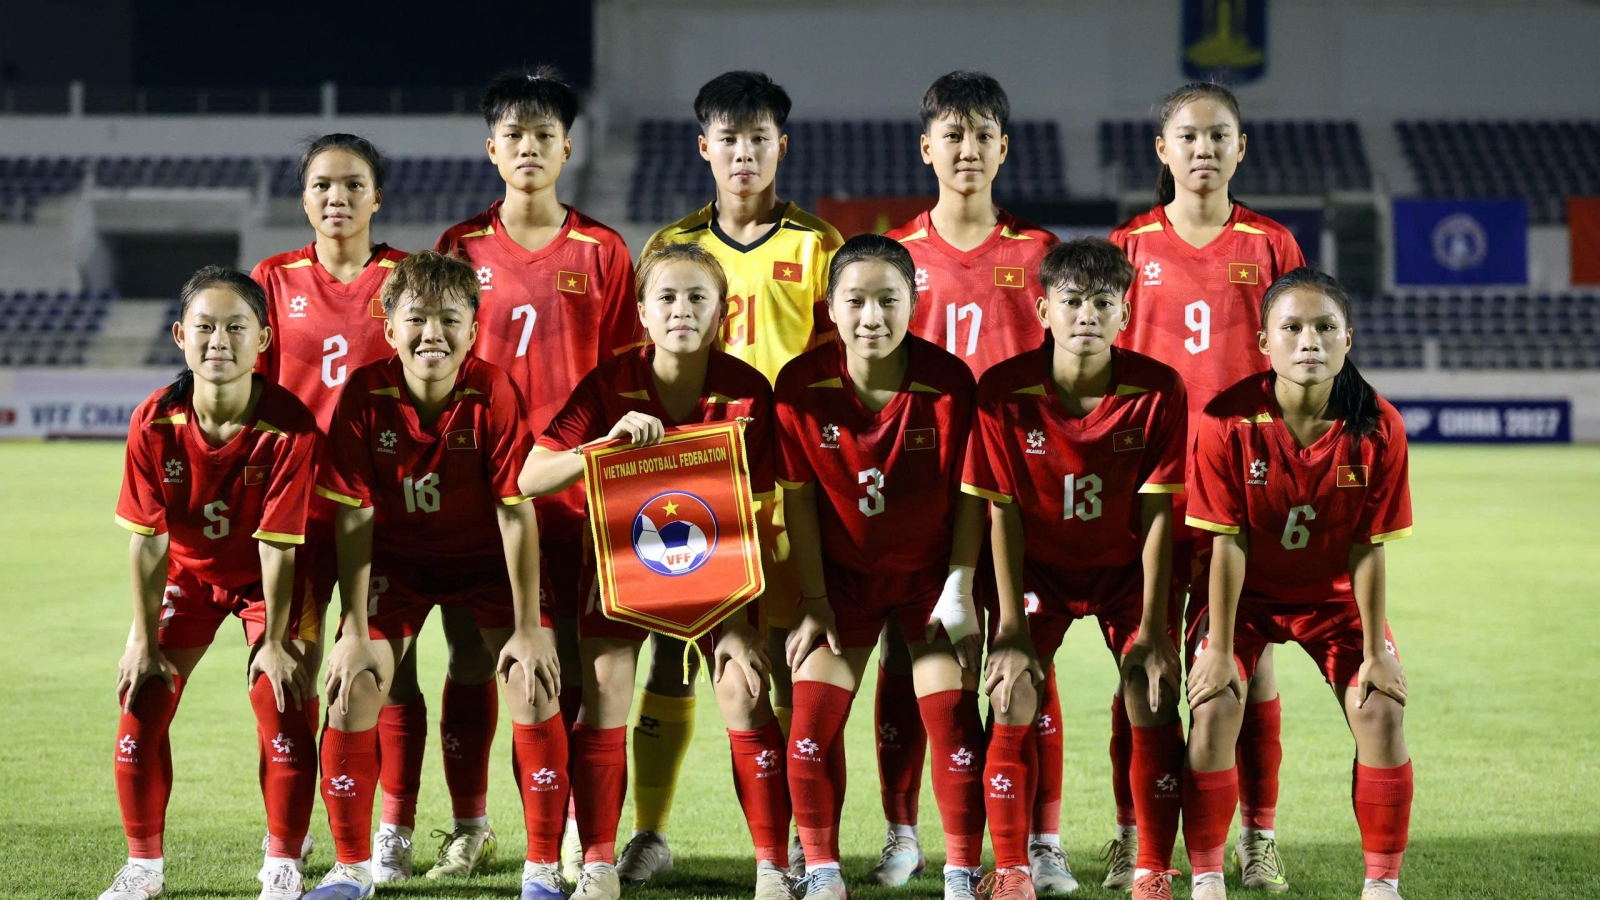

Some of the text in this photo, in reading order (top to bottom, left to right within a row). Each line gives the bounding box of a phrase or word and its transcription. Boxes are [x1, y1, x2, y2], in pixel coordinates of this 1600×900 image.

[511, 303, 537, 358] 7
[723, 294, 756, 346] 21
[946, 301, 983, 357] 17
[1184, 299, 1211, 355] 9
[321, 333, 348, 389] 2
[79, 403, 138, 429] CHA
[1438, 407, 1500, 437] CHINA
[1503, 407, 1561, 437] 2027
[603, 446, 727, 480] VIETNAM FOOTBALL FEDERATION
[403, 472, 440, 513] 18
[857, 467, 885, 517] 3
[1063, 473, 1102, 521] 13
[203, 500, 229, 540] 5
[1280, 504, 1316, 550] 6
[666, 552, 691, 566] VFF
